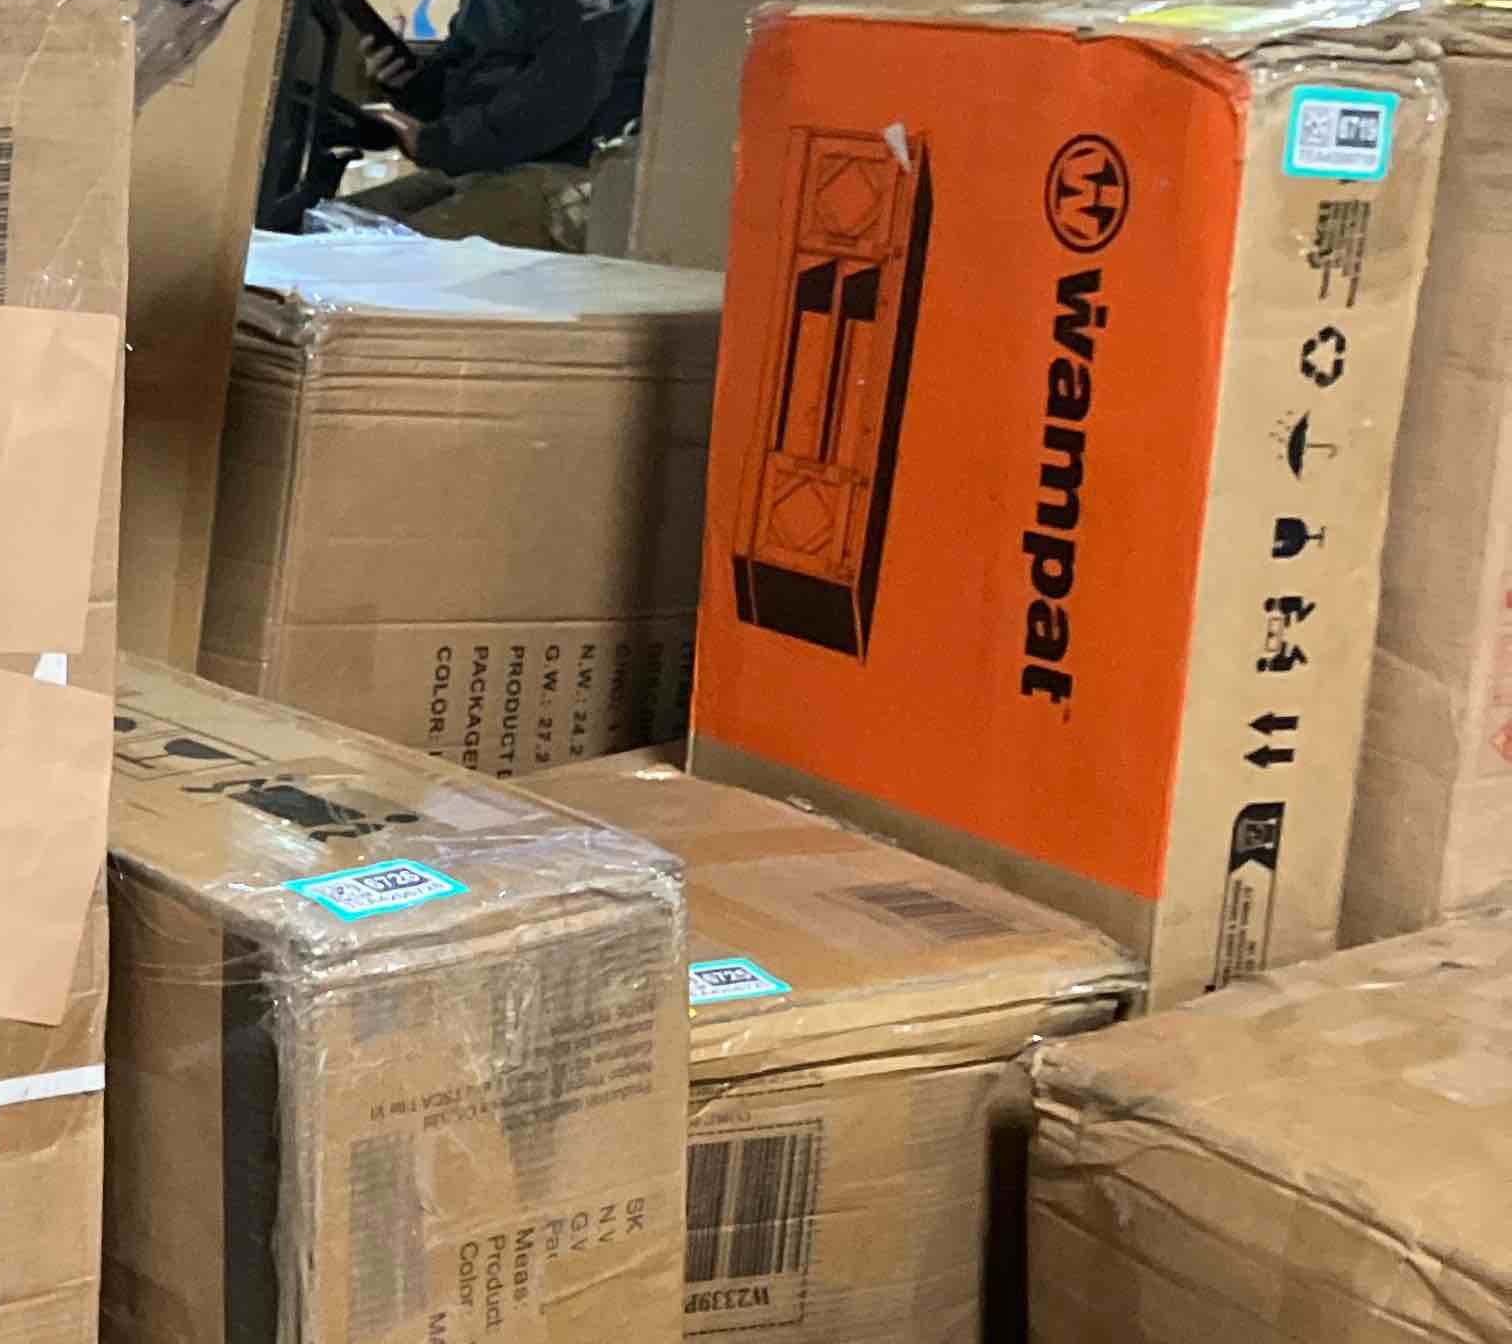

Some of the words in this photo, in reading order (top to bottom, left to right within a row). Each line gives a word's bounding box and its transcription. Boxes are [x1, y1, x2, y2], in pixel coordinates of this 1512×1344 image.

[1019, 267, 1108, 704] wampat
[462, 645, 490, 770] PACKAGE
[498, 645, 526, 764] PRODUCT
[625, 1196, 645, 1234] SK
